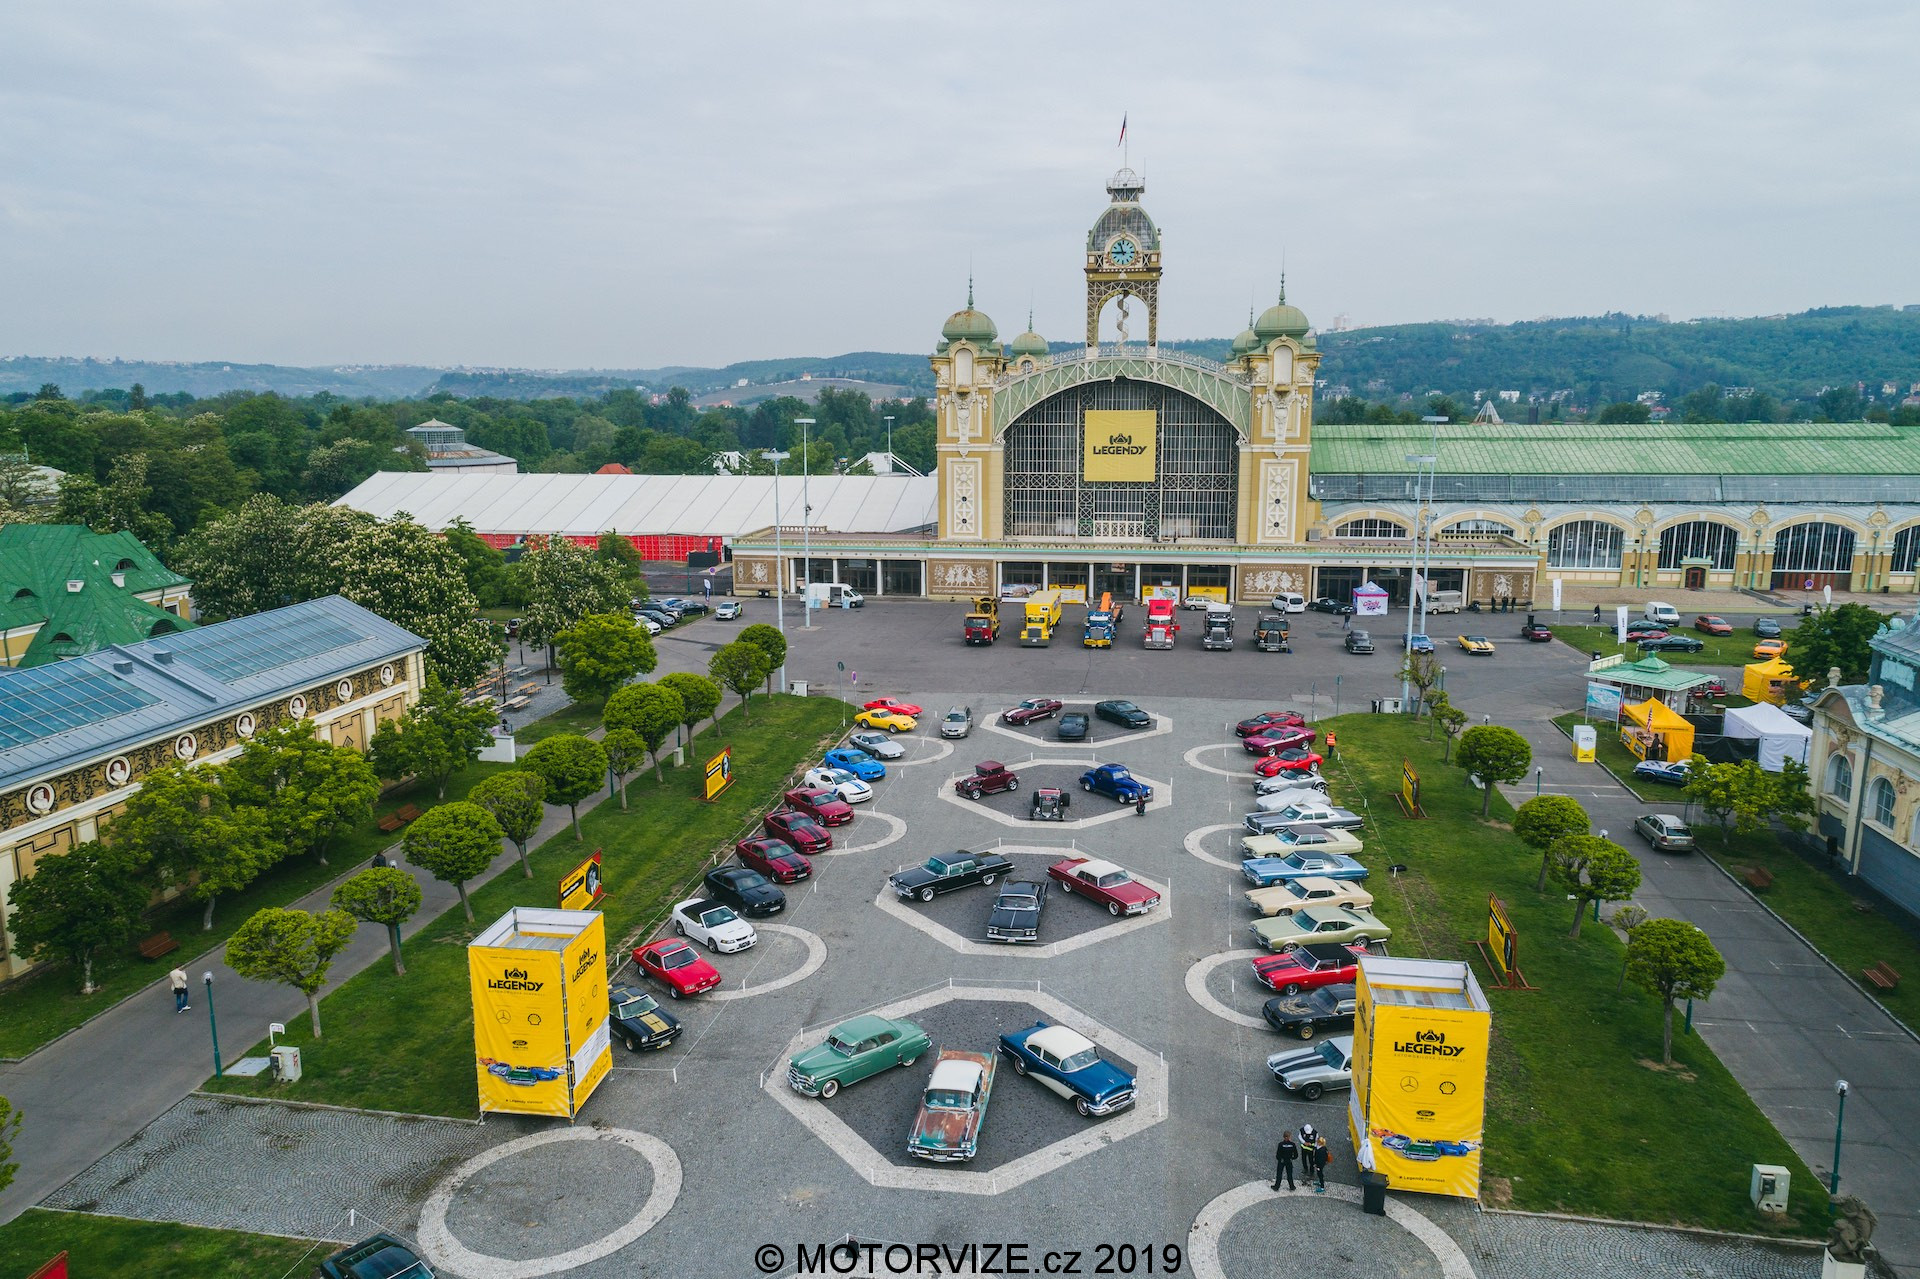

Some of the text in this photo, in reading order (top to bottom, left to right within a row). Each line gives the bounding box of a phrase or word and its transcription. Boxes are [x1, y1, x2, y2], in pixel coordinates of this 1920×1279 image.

[1093, 445, 1147, 455] LEGENDY
[572, 950, 598, 983] LEGENDY
[488, 979, 544, 991] LEGENDY
[1394, 1041, 1465, 1057] LEGENDY
